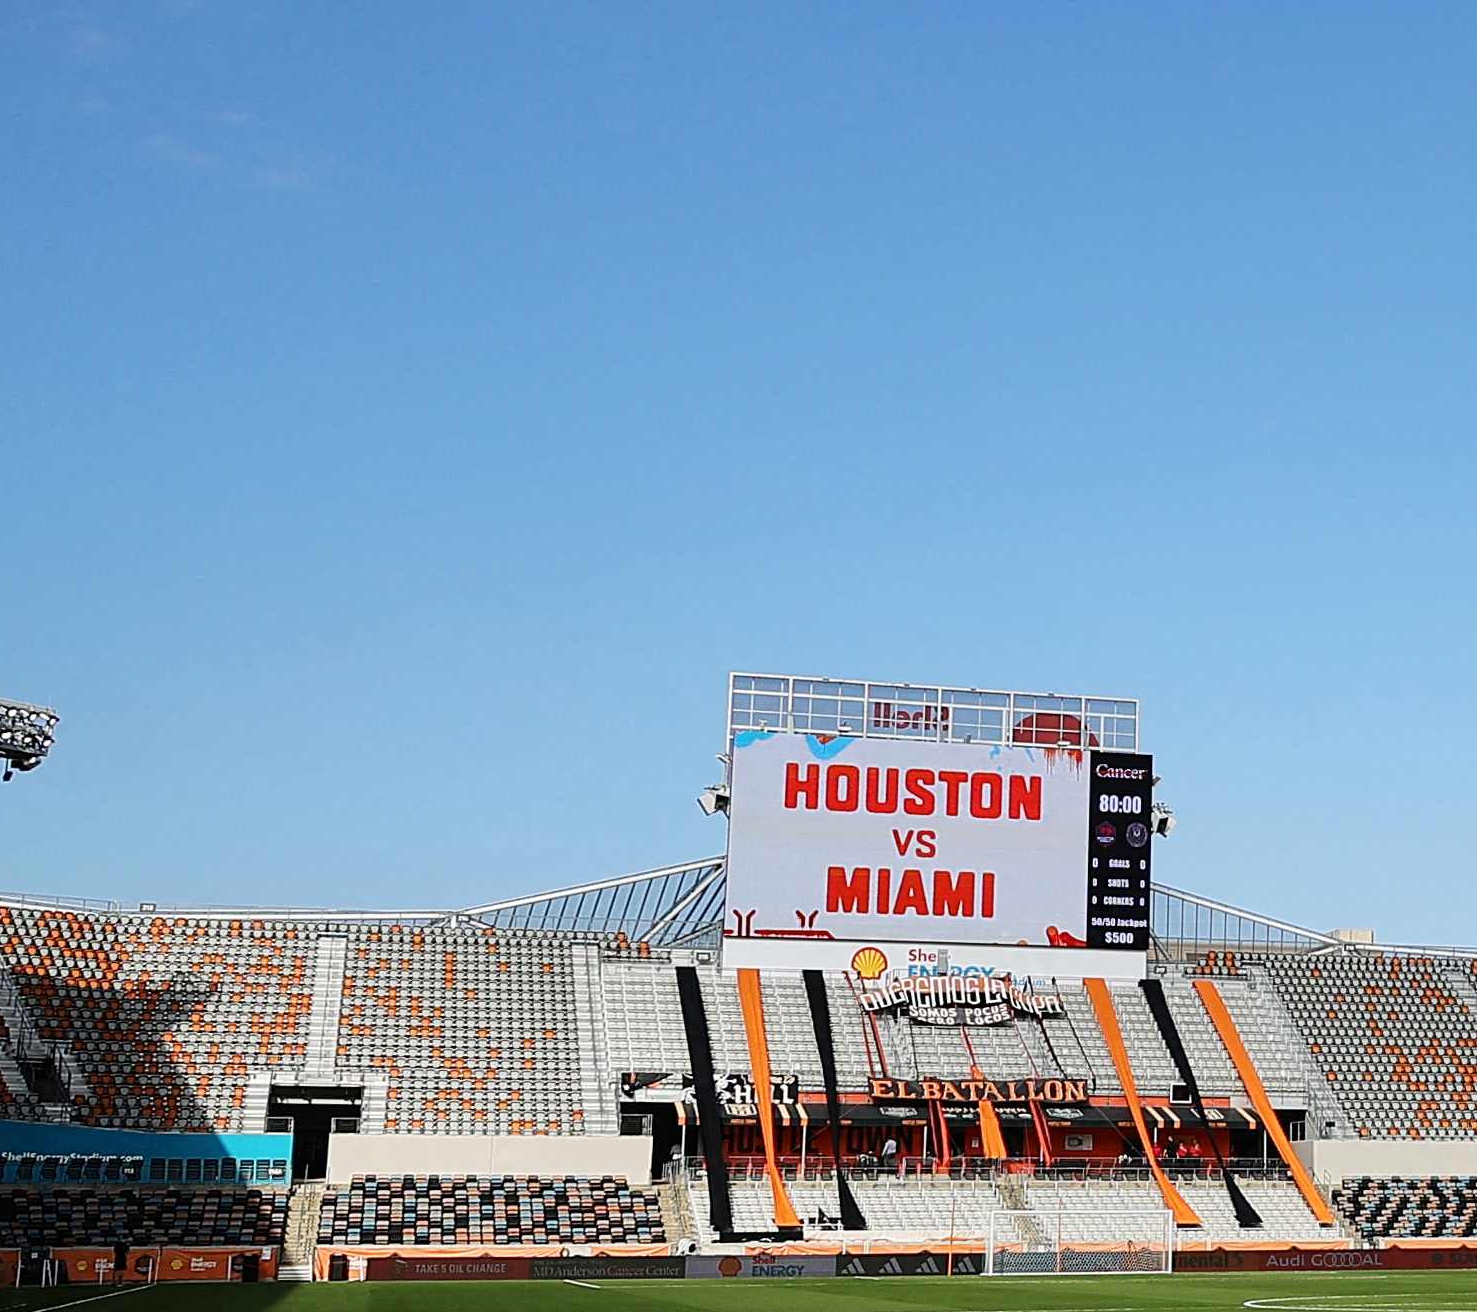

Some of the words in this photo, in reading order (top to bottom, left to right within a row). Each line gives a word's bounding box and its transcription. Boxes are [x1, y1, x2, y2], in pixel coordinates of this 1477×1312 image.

[1095, 763, 1148, 781] Cancer
[784, 762, 1042, 820] HOUSTON
[1099, 793, 1142, 814] 80:00
[892, 829, 936, 858] VS
[1092, 857, 1099, 869] 0
[1139, 859, 1146, 870] 0
[1139, 879, 1146, 889] 0
[826, 867, 995, 918] MIAMI
[1091, 895, 1098, 905] 0
[1139, 896, 1145, 906] 0
[1104, 931, 1134, 944] $500
[909, 1004, 957, 1017] SOMOS
[965, 1010, 1010, 1025] LOCOS
[871, 1078, 917, 1099] EL
[920, 1078, 1088, 1102] BATALLON
[1266, 1254, 1304, 1267] Audi
[414, 1263, 438, 1274] TAKE
[448, 1263, 465, 1274] OIL
[466, 1263, 507, 1275] CHANGE
[555, 1265, 605, 1278] Anderson
[606, 1266, 646, 1278] Cancer
[646, 1266, 681, 1278] Center
[752, 1265, 804, 1277] ENERGY
